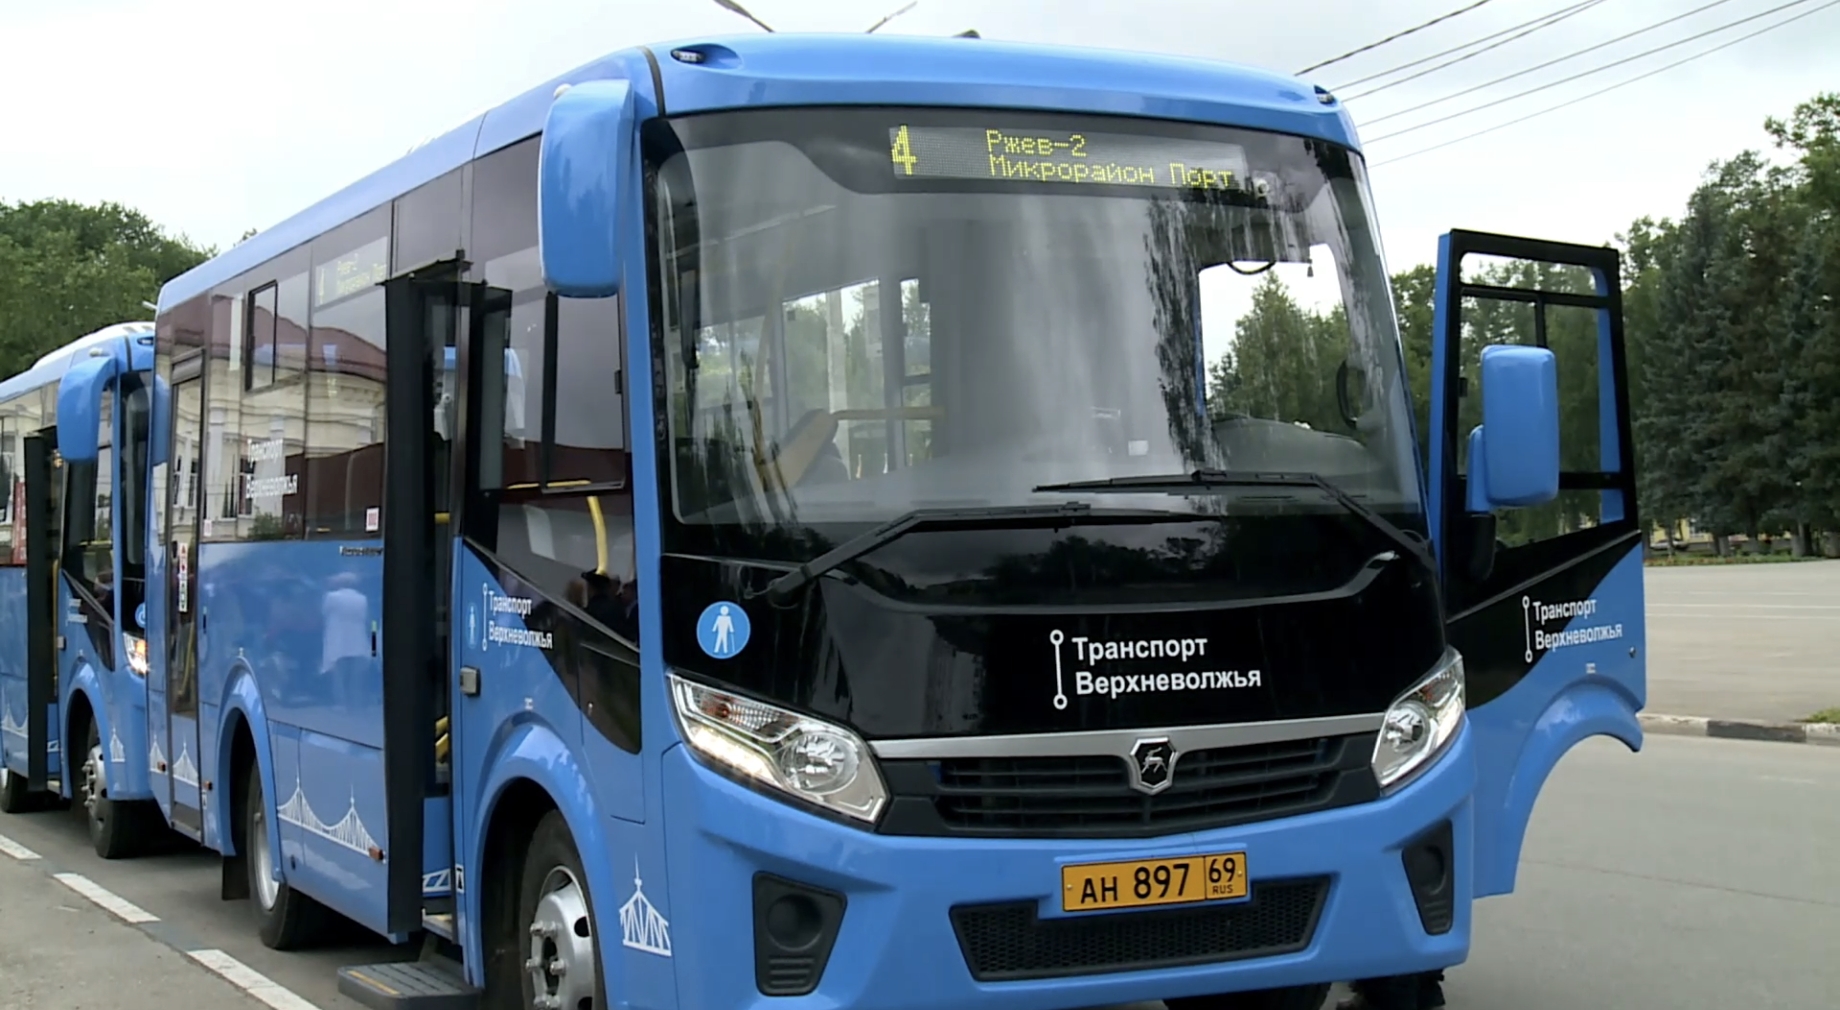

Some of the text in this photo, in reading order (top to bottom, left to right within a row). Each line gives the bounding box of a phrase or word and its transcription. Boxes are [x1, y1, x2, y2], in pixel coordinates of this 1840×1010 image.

[891, 125, 917, 175] 4
[985, 129, 1087, 158] Ржев-2
[989, 153, 1234, 188] Микрорайон Порт
[488, 590, 532, 619] Транспорт
[1532, 599, 1597, 625] Транспорт
[488, 620, 553, 649] Верхневолжья
[1534, 623, 1623, 652] Верхневолжья
[1071, 637, 1208, 666] Транспорт
[1075, 670, 1262, 699] Верхневолжья
[1133, 863, 1190, 899] 897
[1208, 857, 1236, 883] 69
[1212, 884, 1234, 895] RUS
